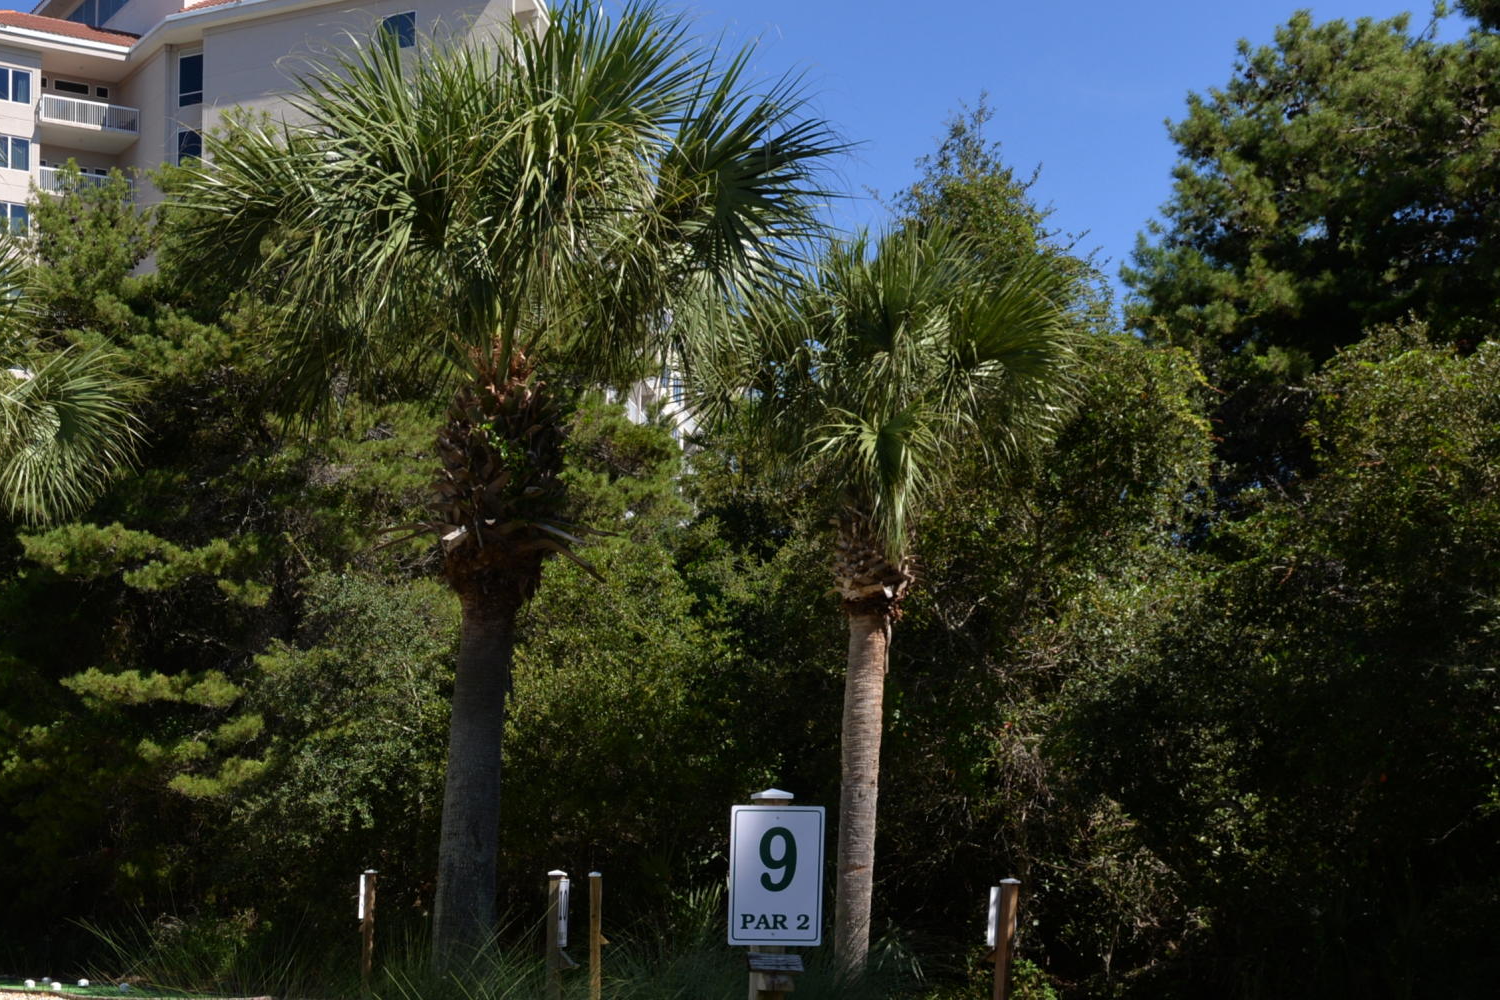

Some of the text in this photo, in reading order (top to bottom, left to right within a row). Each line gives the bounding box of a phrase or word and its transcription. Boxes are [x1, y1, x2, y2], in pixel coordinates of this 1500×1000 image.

[759, 826, 797, 892] 9
[740, 913, 810, 930] PAR 2
